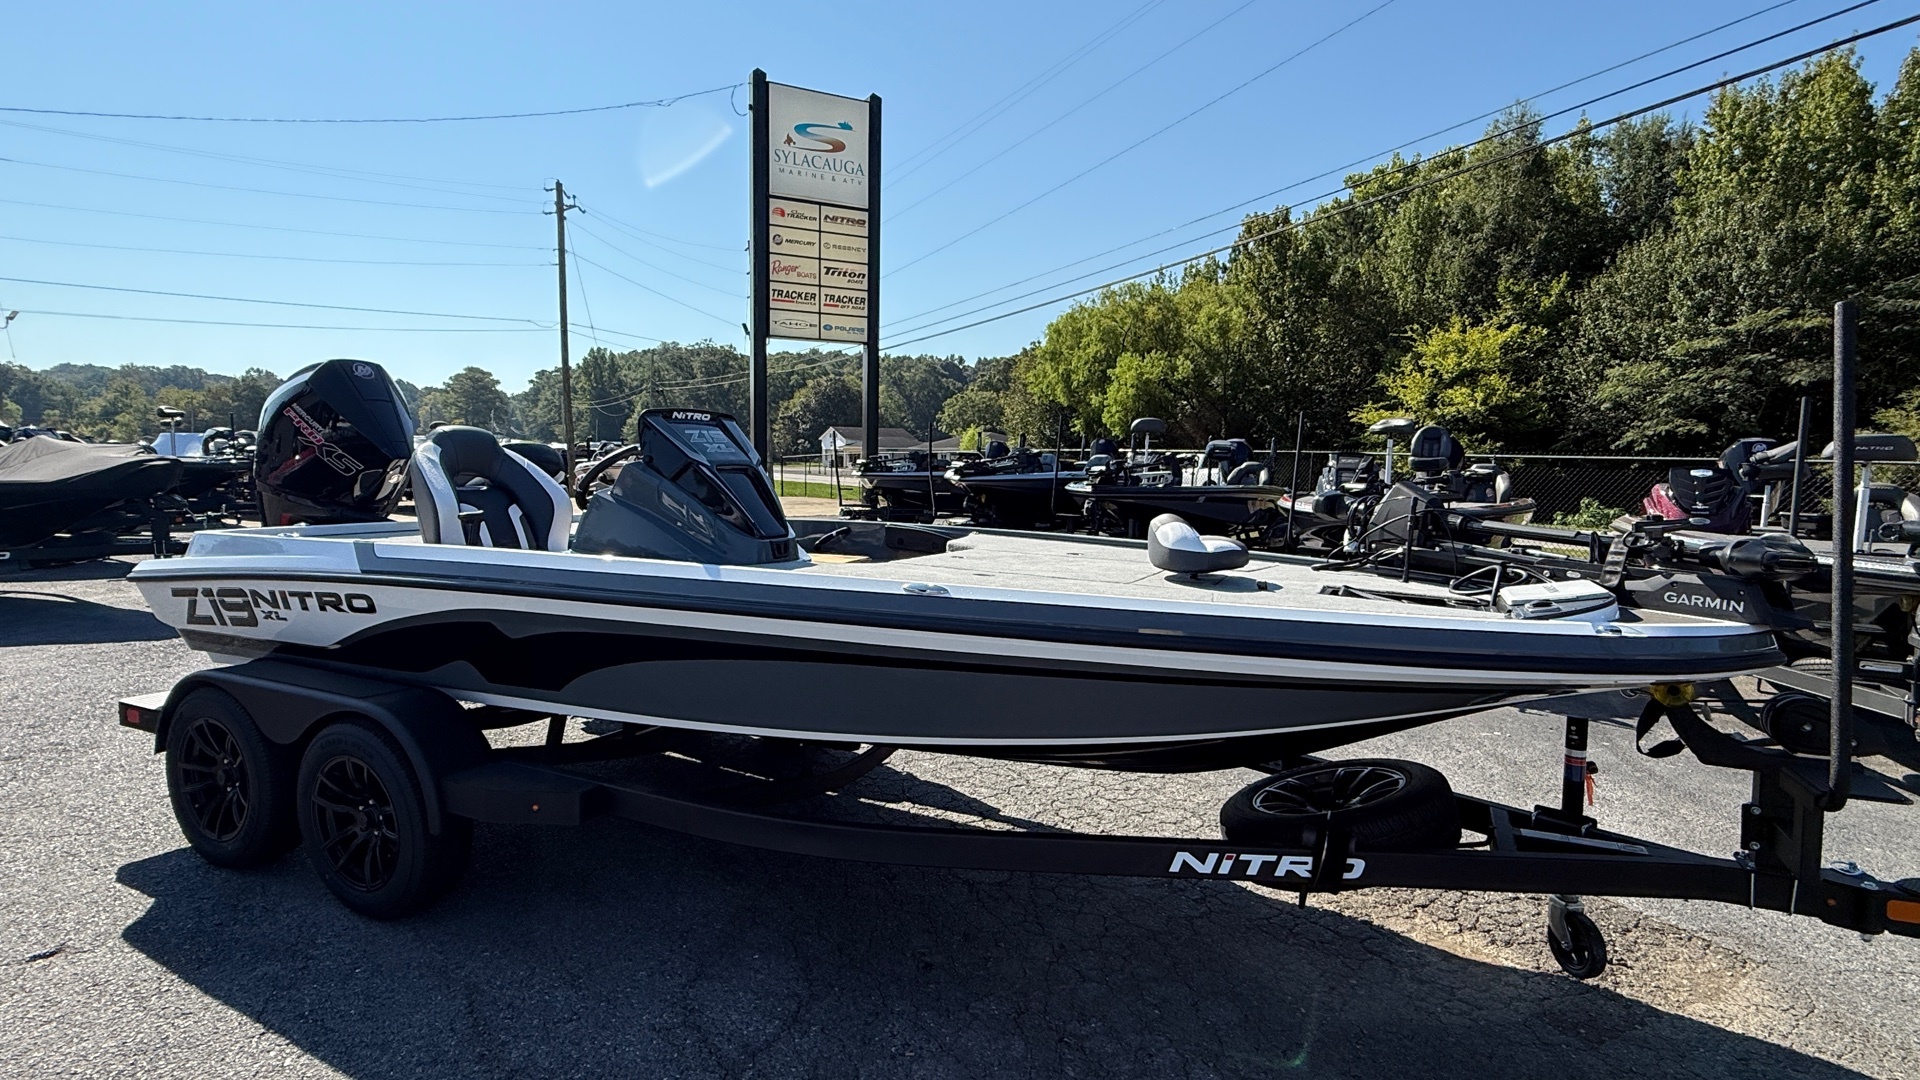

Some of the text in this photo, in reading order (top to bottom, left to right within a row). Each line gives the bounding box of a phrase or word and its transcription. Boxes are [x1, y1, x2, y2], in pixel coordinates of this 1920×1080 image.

[774, 148, 865, 177] SYLACAUGA
[779, 167, 825, 181] MARINE
[842, 177, 862, 186] ATV
[787, 212, 818, 222] TRACKER
[785, 238, 816, 247] MERCURY
[771, 259, 799, 275] Ranger
[823, 266, 866, 280] Triton
[796, 271, 817, 280] BOATS
[771, 288, 817, 302] TRACKER
[823, 293, 866, 306] TRACKER
[772, 319, 818, 328] TAHOE
[834, 325, 866, 333] POLARIS
[291, 403, 325, 432] MERCURY
[283, 406, 325, 446] PRO
[684, 429, 729, 443] Z19
[702, 443, 736, 453] XL
[170, 587, 377, 628] Z19 NITRO
[1663, 591, 1745, 613] GARMIN
[260, 609, 288, 622] XL
